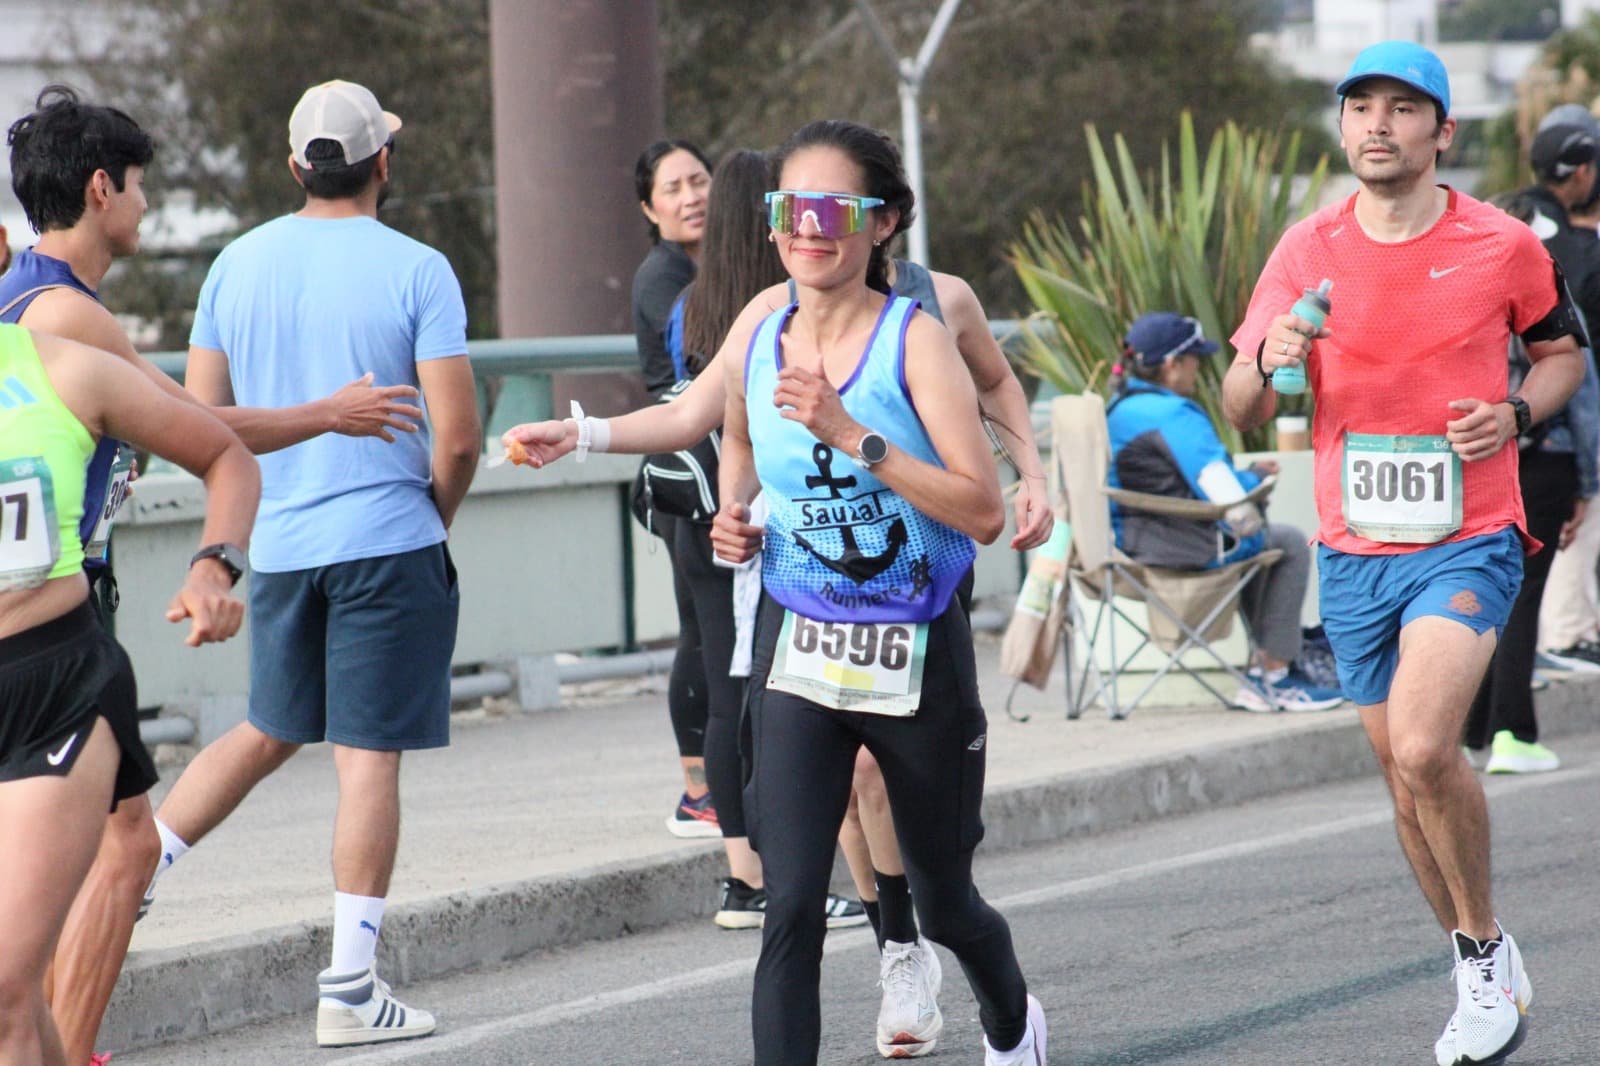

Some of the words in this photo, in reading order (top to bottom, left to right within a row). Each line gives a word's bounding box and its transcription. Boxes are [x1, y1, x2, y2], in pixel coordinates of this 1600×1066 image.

[1353, 460, 1445, 502] 3061
[0, 491, 29, 544] 7
[801, 493, 885, 527] Sauzal
[818, 581, 901, 609] Runners
[793, 614, 910, 671] 6596
